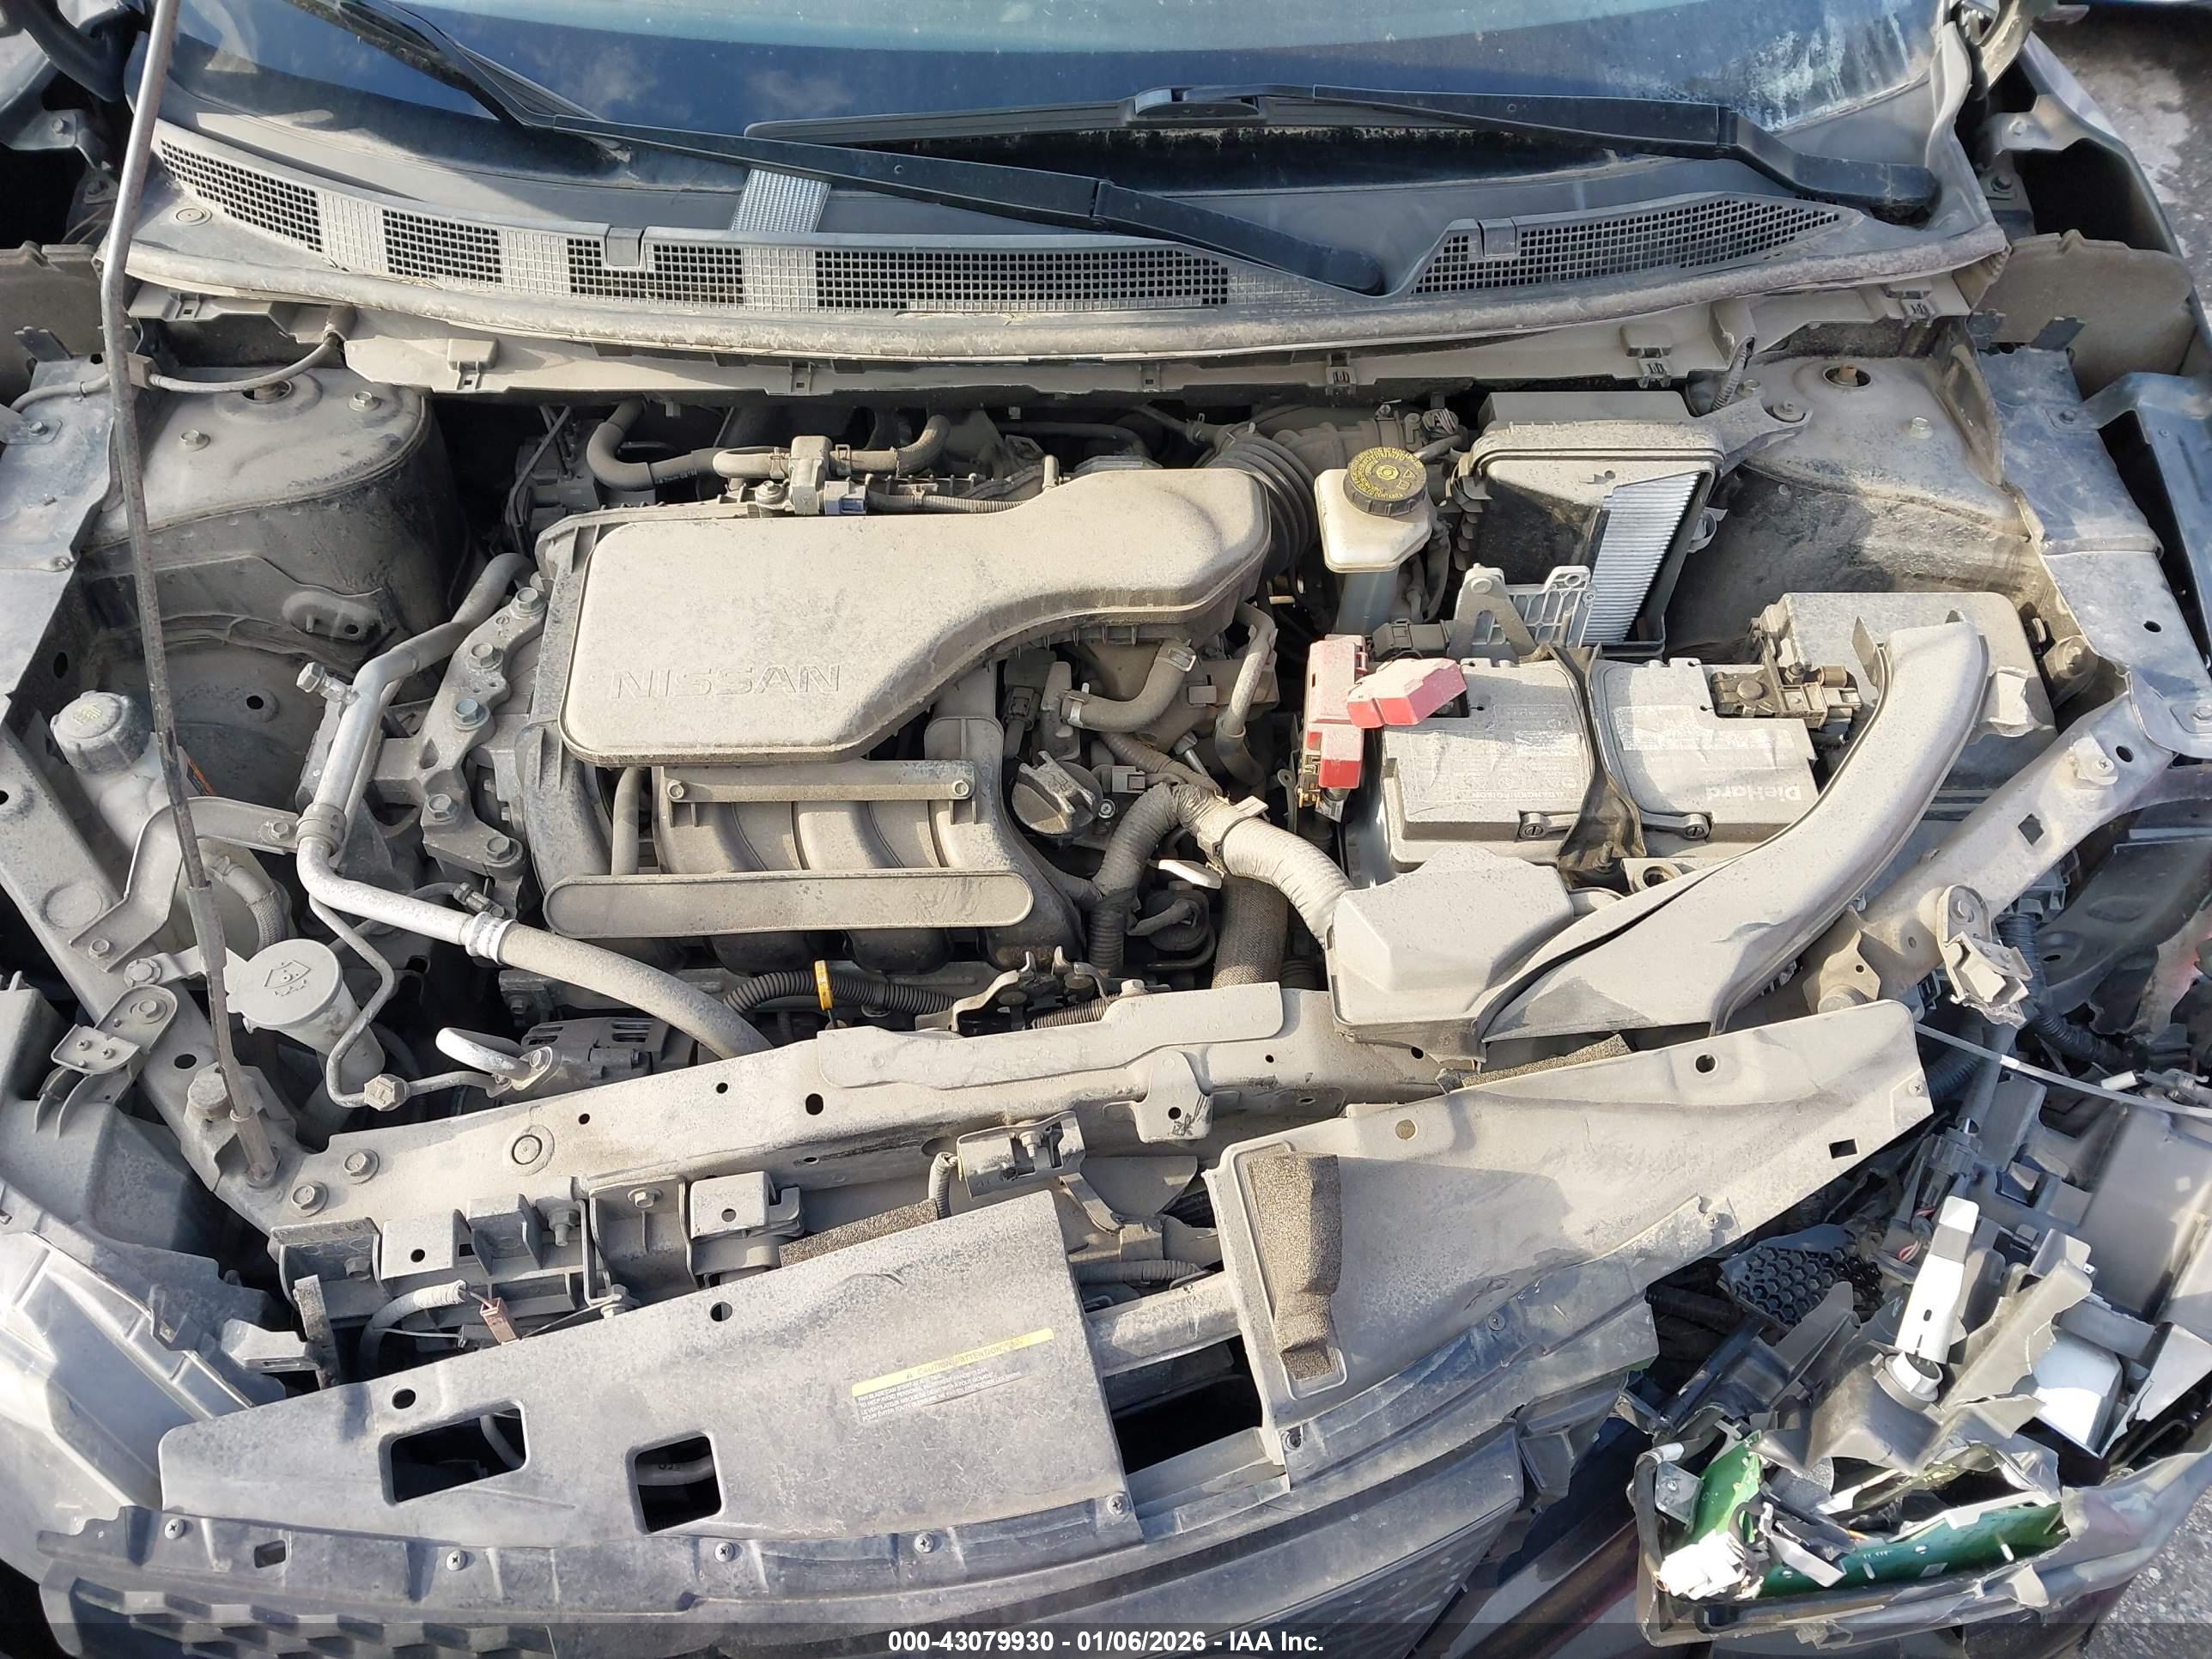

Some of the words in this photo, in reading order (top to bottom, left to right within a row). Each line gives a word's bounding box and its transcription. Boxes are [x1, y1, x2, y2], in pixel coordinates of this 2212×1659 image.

[611, 665, 841, 699] NISSAN
[1705, 785, 1802, 802] DieHard
[960, 1346, 1002, 1364] ATTENTION
